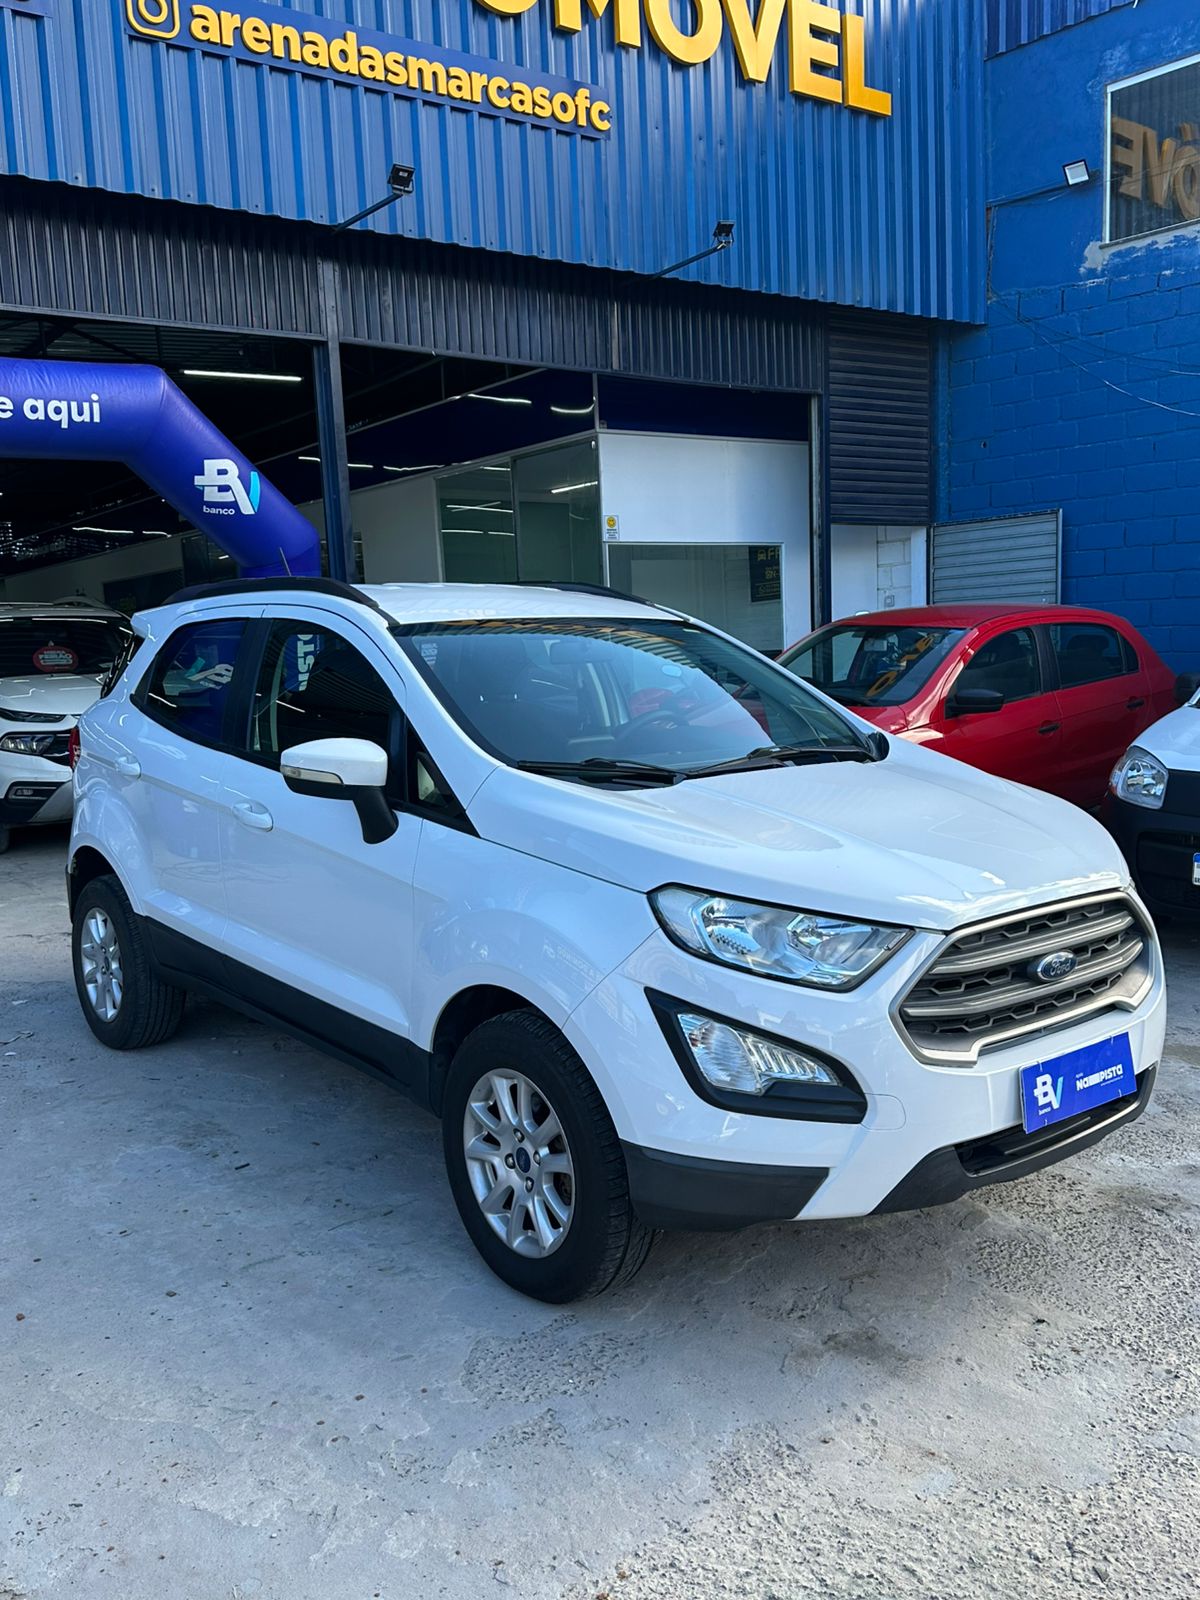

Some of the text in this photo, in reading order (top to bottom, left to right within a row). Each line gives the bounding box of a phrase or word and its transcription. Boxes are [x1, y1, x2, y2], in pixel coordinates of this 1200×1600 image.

[190, 2, 612, 132] arenadasmarcasofc
[473, 0, 892, 117] OVEL
[23, 393, 101, 428] aqui
[202, 505, 236, 516] banco
[1050, 957, 1072, 976] Ford
[1033, 1073, 1064, 1110] BV
